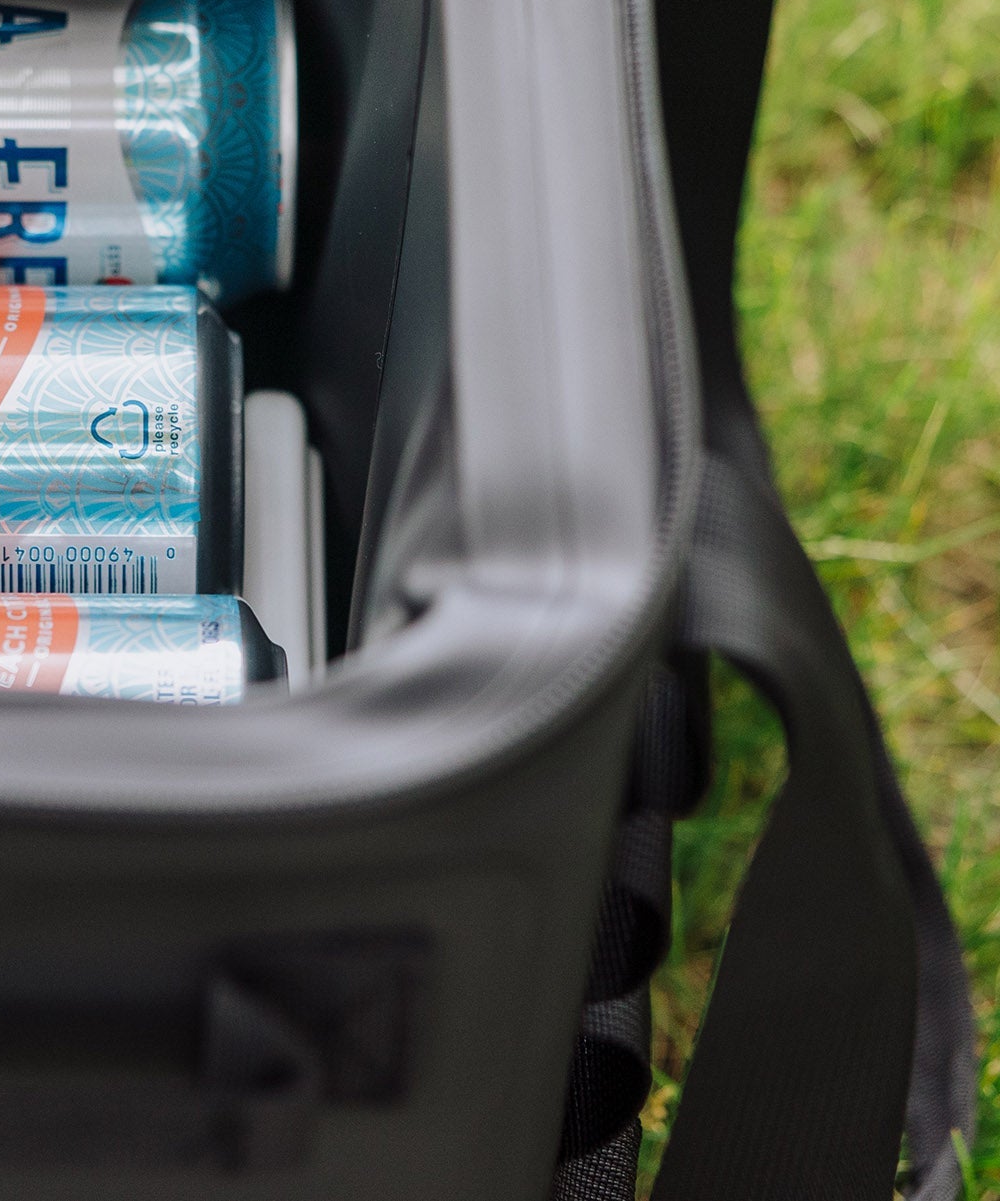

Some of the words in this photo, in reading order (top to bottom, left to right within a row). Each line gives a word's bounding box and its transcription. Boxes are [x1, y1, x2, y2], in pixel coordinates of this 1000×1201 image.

[153, 406, 166, 452] please
[168, 403, 182, 455] recycle
[65, 545, 133, 562] 49000
[166, 547, 175, 559] 0
